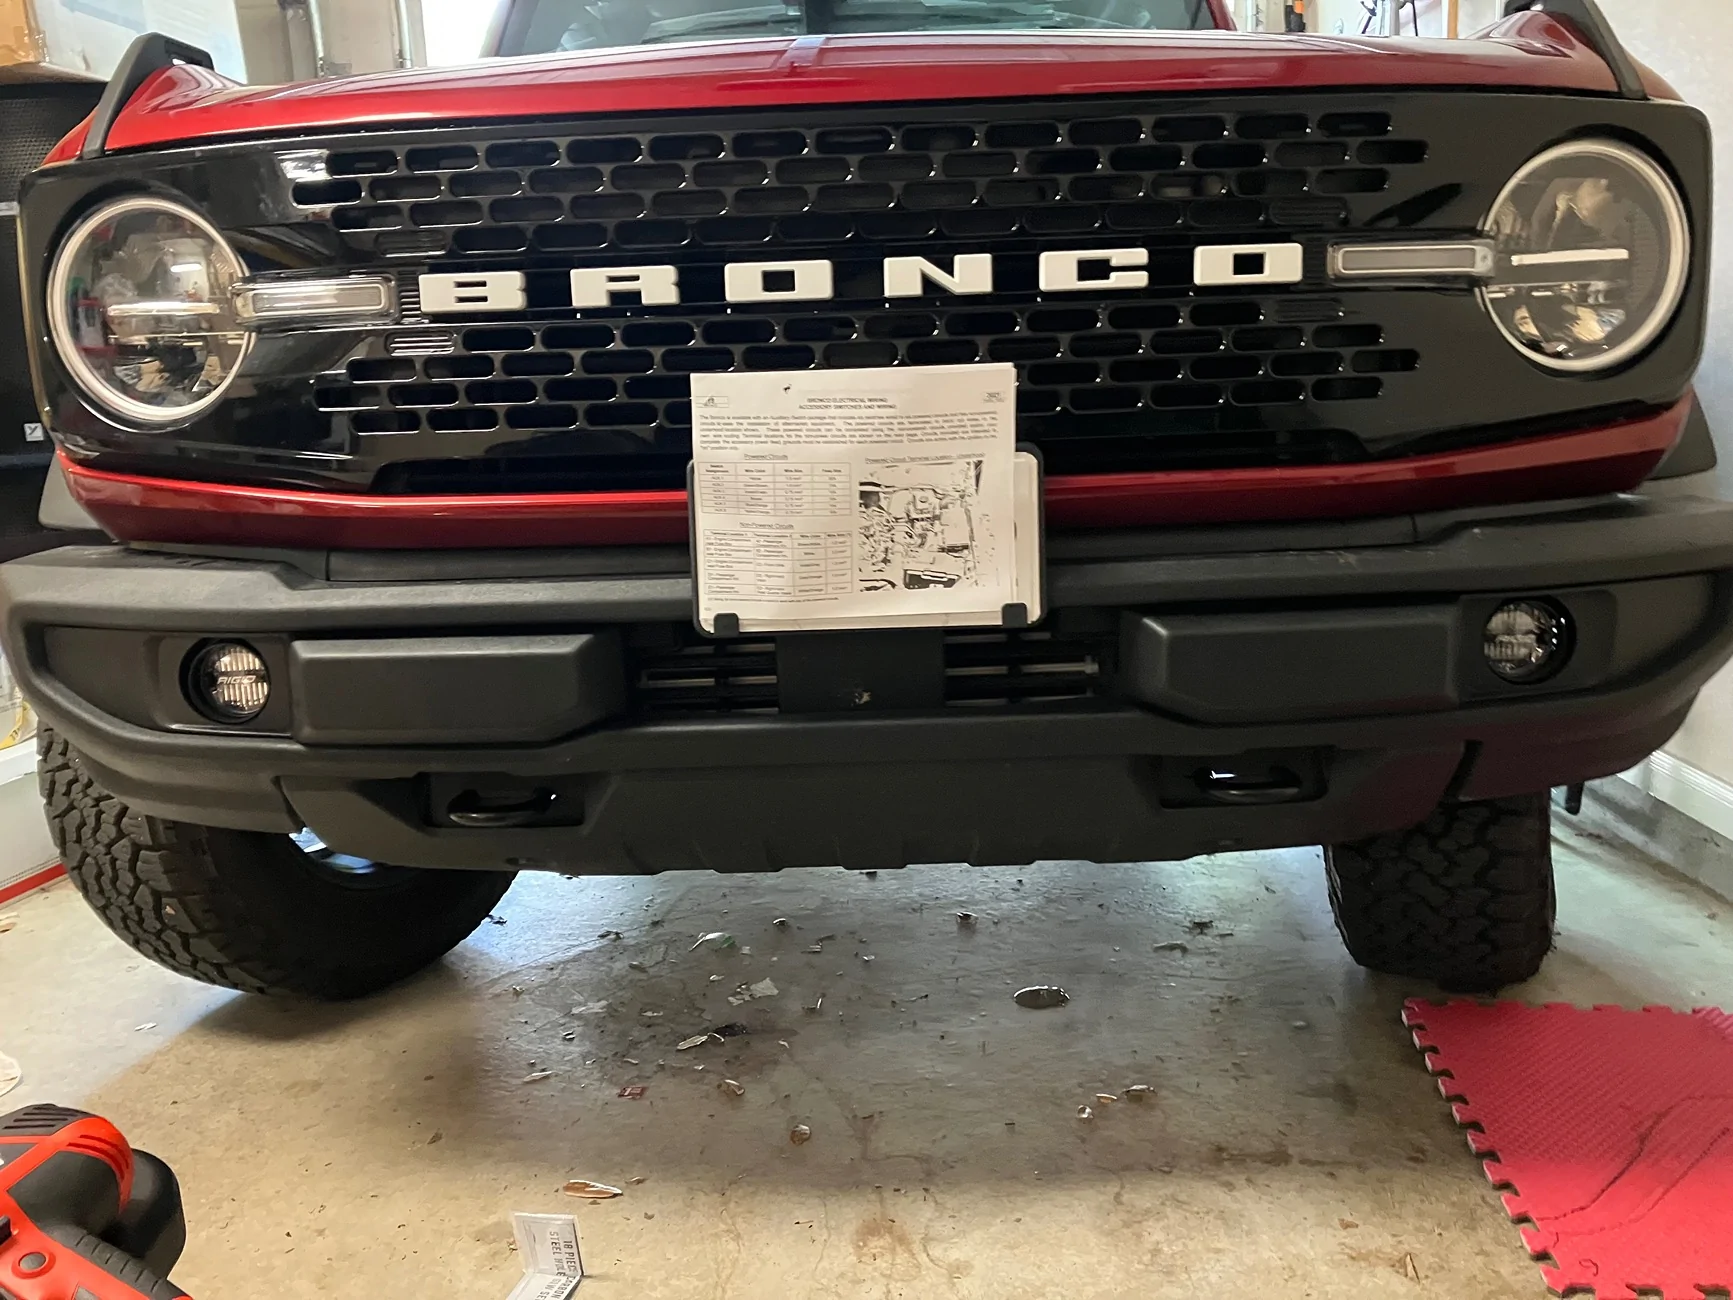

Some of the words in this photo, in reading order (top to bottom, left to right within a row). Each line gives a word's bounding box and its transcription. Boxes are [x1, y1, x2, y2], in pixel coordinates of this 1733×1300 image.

[418, 242, 1303, 313] BRONCO
[549, 1231, 563, 1255] STEEL
[563, 1240, 573, 1249] 18
